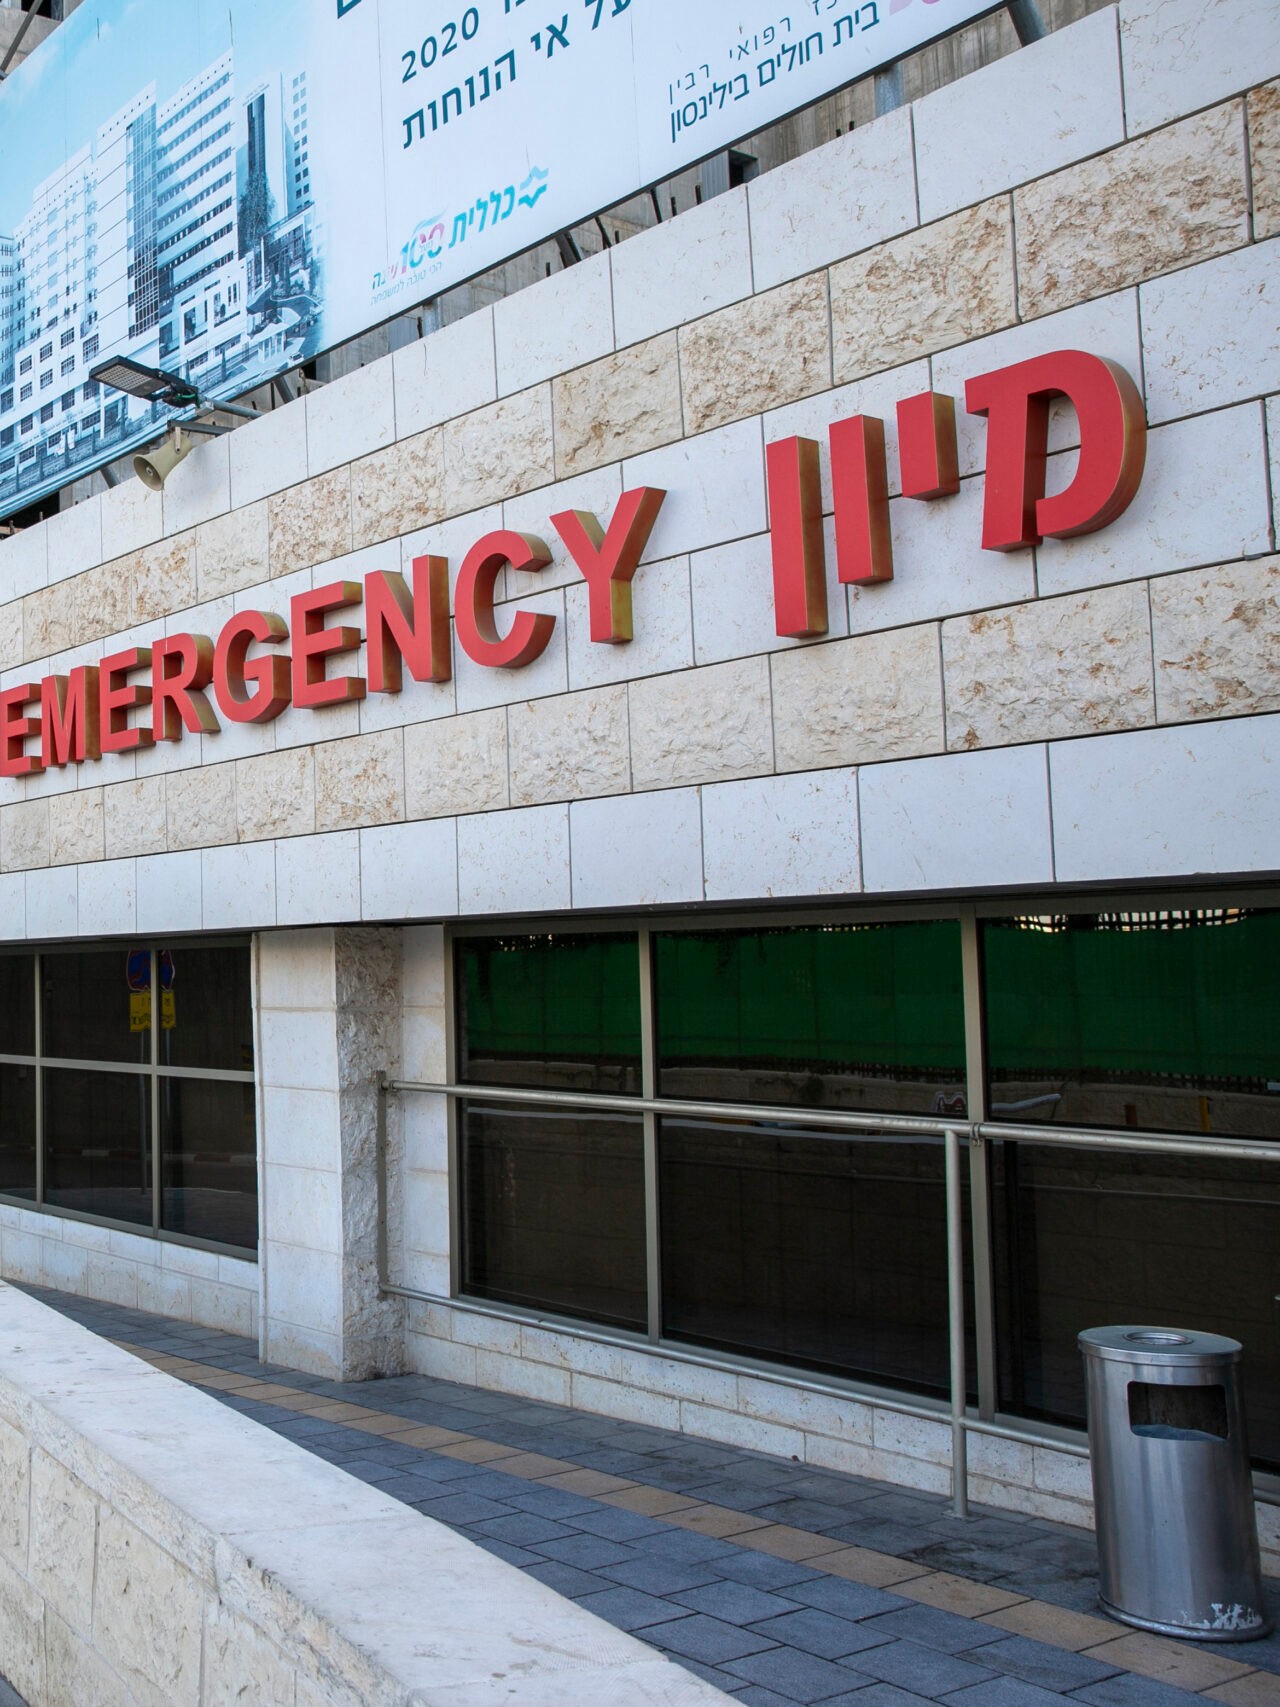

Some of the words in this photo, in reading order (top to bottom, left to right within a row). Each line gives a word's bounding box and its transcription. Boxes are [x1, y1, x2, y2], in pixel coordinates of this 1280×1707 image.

[401, 7, 480, 84] 2020
[530, 13, 570, 58] אי
[729, 17, 791, 61] רפואי
[832, 1, 880, 48] בית
[669, 63, 711, 105] רבין
[757, 31, 824, 88] חולים
[402, 48, 517, 150] הנוחות
[670, 73, 750, 143] בילינסון
[448, 184, 516, 250] כללית
[766, 349, 1148, 639] מיון
[0, 486, 667, 778] EMERGENCY
